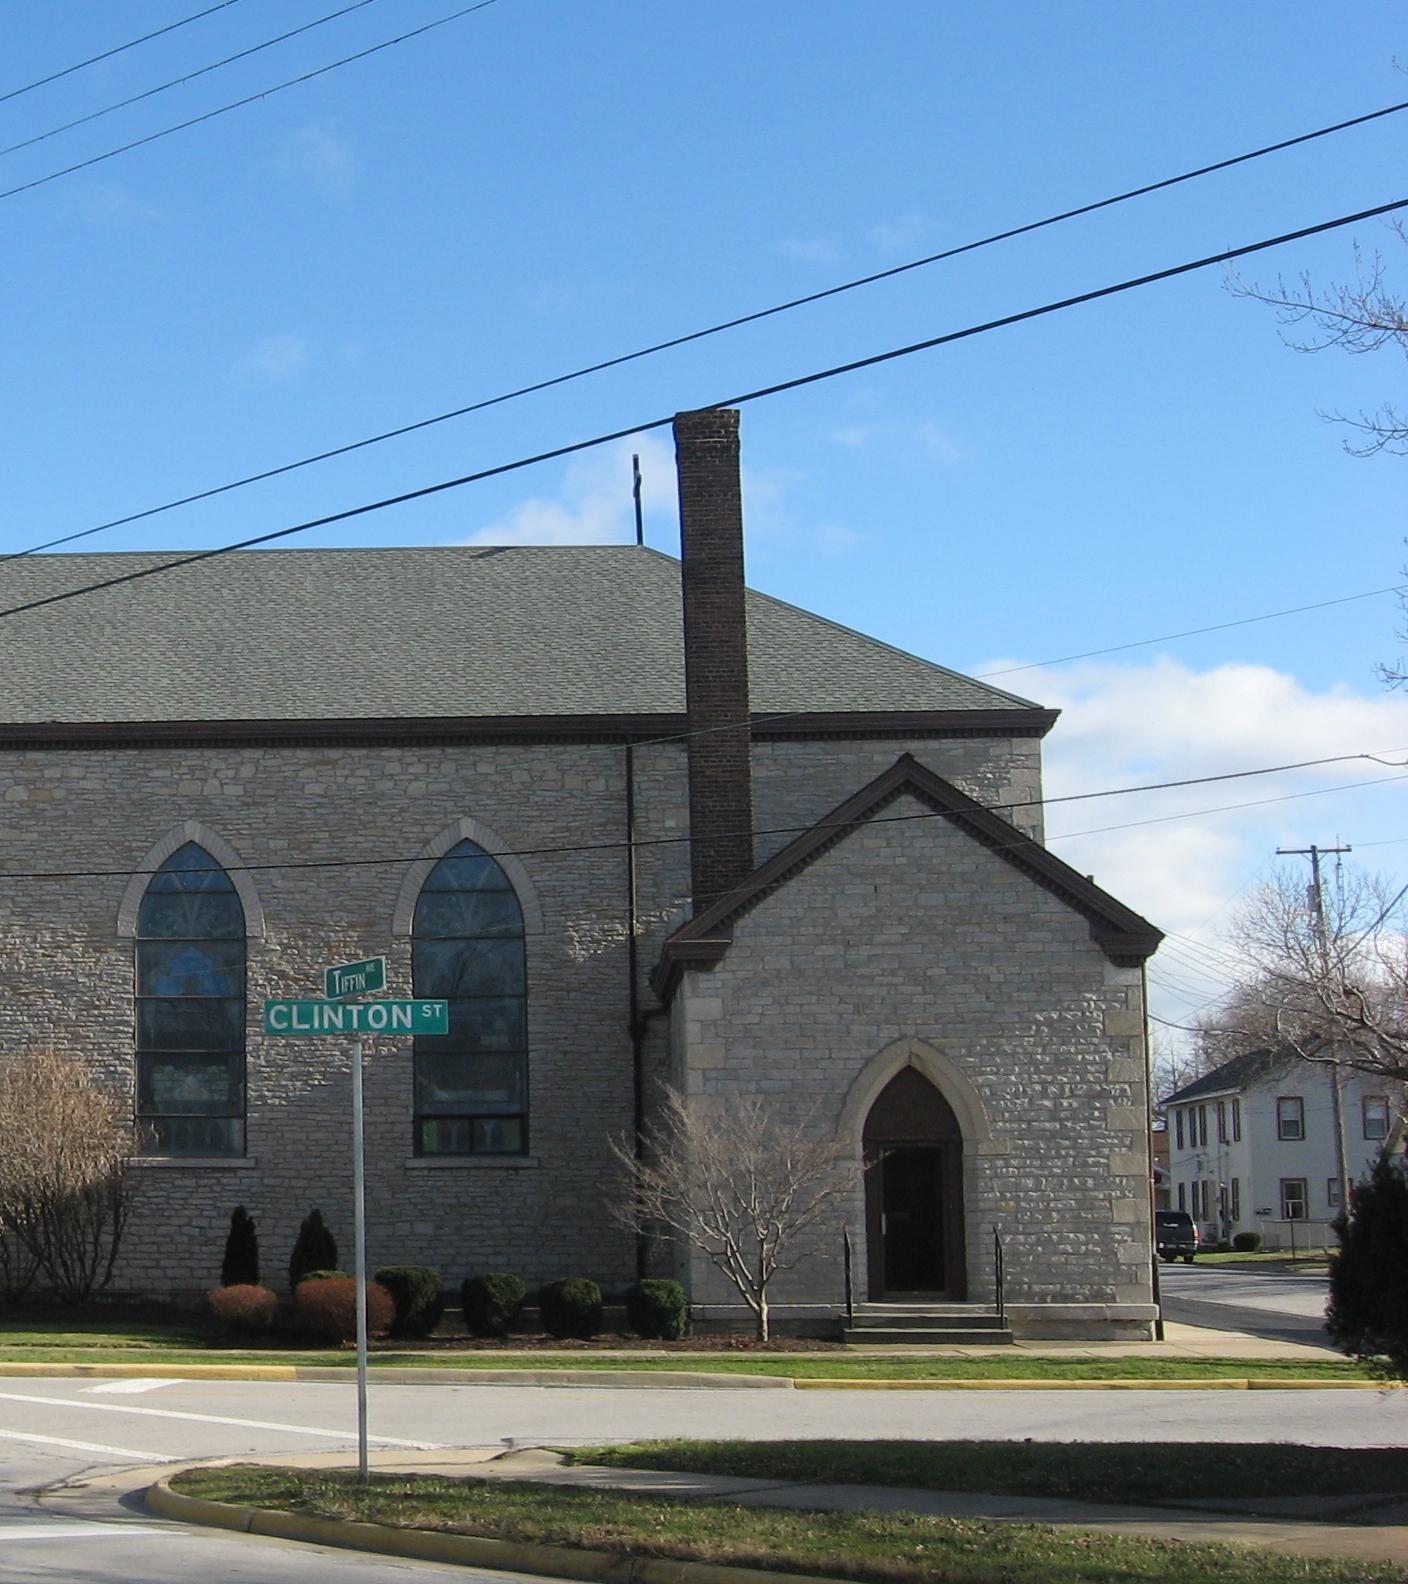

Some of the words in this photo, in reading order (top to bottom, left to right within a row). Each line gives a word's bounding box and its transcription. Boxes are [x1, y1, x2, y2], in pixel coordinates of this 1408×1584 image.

[334, 970, 366, 994] TIFFIN
[366, 962, 376, 973] AVE
[270, 1005, 412, 1030] CLINTON
[421, 1004, 442, 1018] ST
